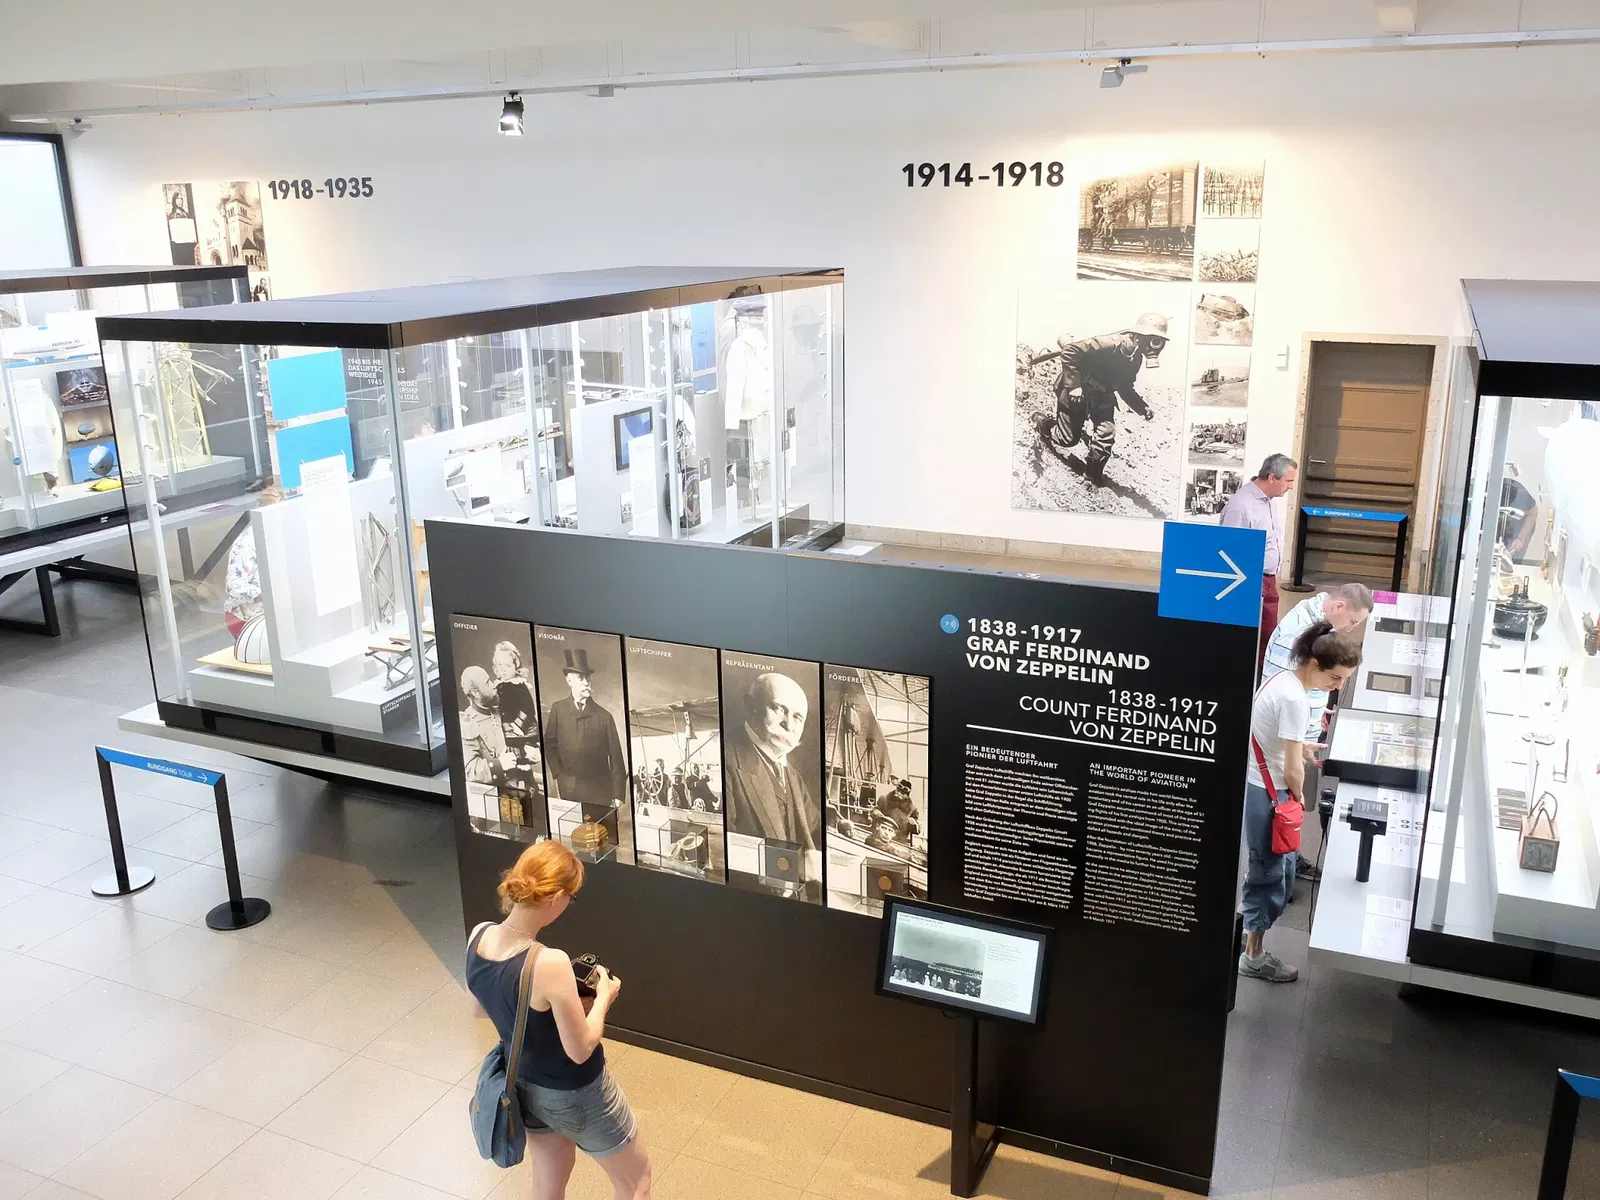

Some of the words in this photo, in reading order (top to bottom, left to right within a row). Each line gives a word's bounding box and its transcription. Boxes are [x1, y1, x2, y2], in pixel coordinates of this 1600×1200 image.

[902, 161, 1065, 188] 1914-1918
[268, 177, 375, 200] 1918-1935
[453, 622, 478, 630] OFFIZIER
[537, 631, 565, 641] VISIONÄR
[629, 646, 672, 658] LUFTSCHIFFER
[966, 636, 1020, 655] GRAF
[1026, 644, 1150, 671] FERDINAND
[725, 659, 775, 671] REPRÄSENTANT
[966, 653, 1010, 672] VON
[1016, 660, 1114, 685] ZEPPELIN
[828, 673, 864, 683] FÖRDERER
[1019, 695, 1091, 719] COUNT
[1095, 706, 1217, 736] FERDINAND
[1069, 720, 1114, 740] VON
[1120, 728, 1215, 755] ZEPPELIN
[965, 750, 997, 761] PIONIER
[998, 754, 1014, 763] DER
[1016, 757, 1059, 769] LUFTFAHRT
[966, 744, 979, 752] EIN
[981, 746, 1036, 760] BEDEUTENDER
[147, 762, 177, 775] RUNDGANG
[178, 769, 193, 778] TOUR
[1089, 762, 1101, 770] AN
[1103, 764, 1148, 777] IMPORTANT
[1150, 771, 1185, 783] PIONEER
[1187, 776, 1196, 784] IN
[1089, 768, 1105, 777] THE
[1106, 771, 1135, 781] WORLD
[1137, 775, 1148, 783] OF
[1150, 777, 1189, 789] AVIATION
